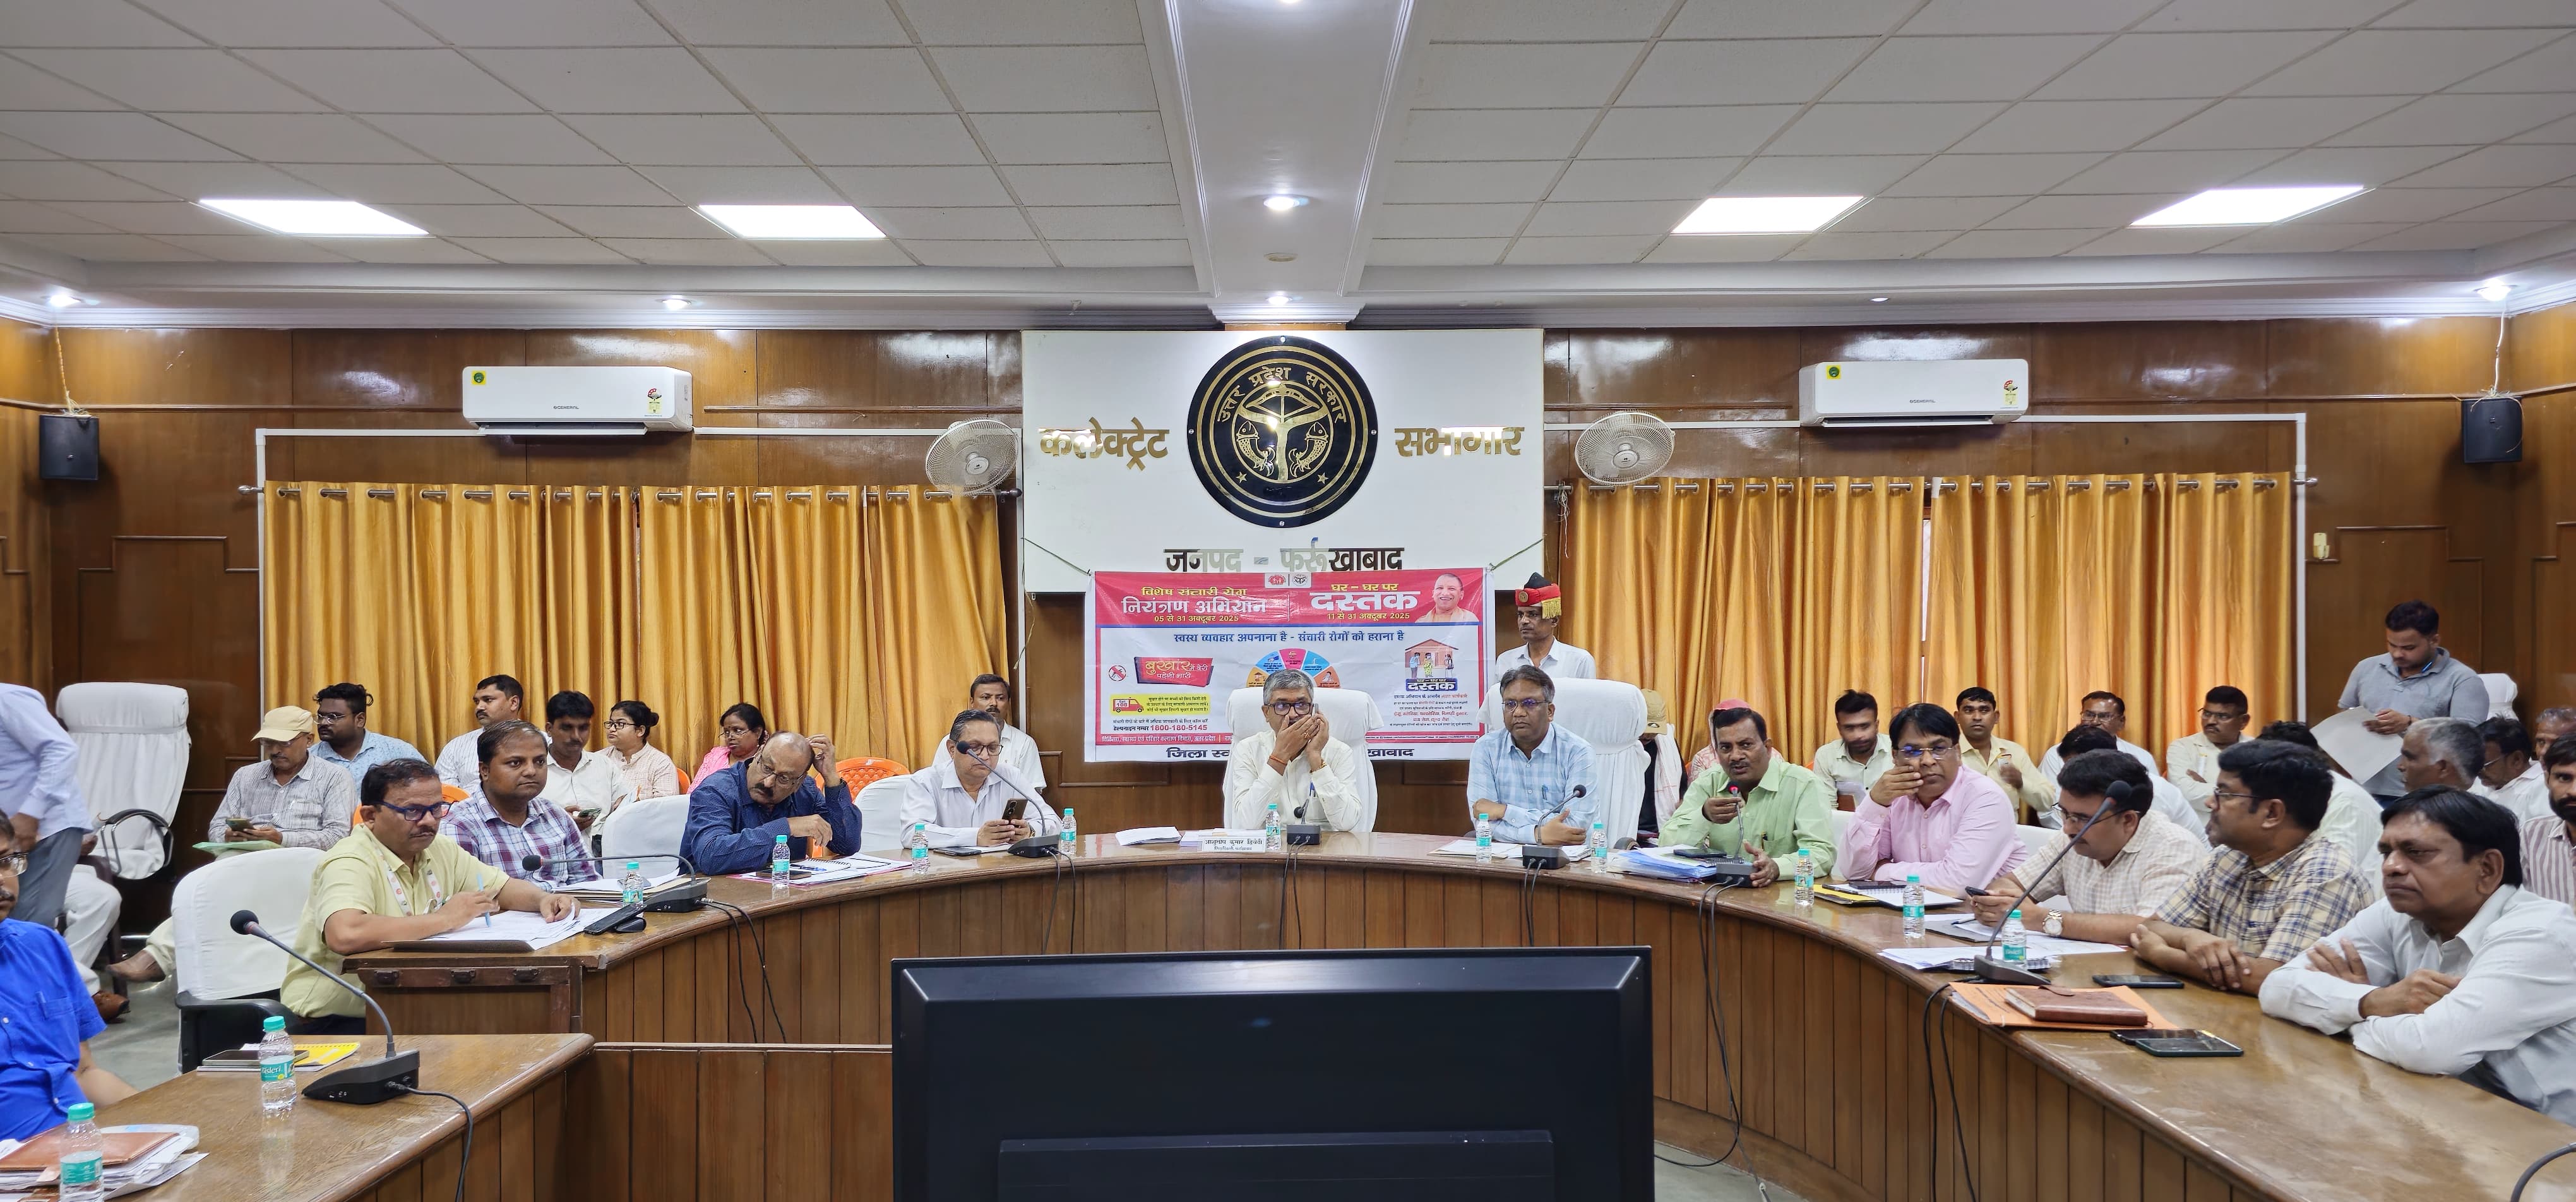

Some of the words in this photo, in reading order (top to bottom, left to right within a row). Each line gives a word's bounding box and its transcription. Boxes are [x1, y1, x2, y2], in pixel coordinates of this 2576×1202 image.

[1217, 385, 1245, 423] उत्तर
[1248, 366, 1291, 387] प्रदेश
[1306, 371, 1347, 423] सरकार
[1039, 417, 1169, 471] कलेक्ट्रेट
[1394, 426, 1525, 457] सभागार
[1164, 548, 1244, 572] जनपद
[1142, 587, 1173, 596] विशेष
[1178, 586, 1219, 596] संचारी
[1222, 587, 1248, 596] रोग
[1362, 583, 1380, 591] घर
[1121, 596, 1190, 614] नियंत्रण
[1195, 596, 1267, 613] अभियान
[1309, 591, 1421, 611] दस्तक
[1167, 614, 1174, 622] से
[1188, 615, 1216, 623] अक्टूबर
[1337, 611, 1345, 620] से
[1359, 613, 1387, 622] अक्टूबर
[1174, 634, 1198, 642] स्वस्थ
[1202, 634, 1232, 642] व्यवहार
[1237, 634, 1277, 642] अपनाना
[1280, 630, 1289, 642] है
[1298, 631, 1327, 642] संचारी
[1329, 631, 1350, 642] रोगों
[1352, 632, 1365, 642] को
[1368, 632, 1395, 641] हराना
[1398, 630, 1405, 641] है
[1145, 659, 1191, 675] बुखार
[1407, 682, 1456, 690] दस्तक
[1166, 747, 1208, 758] जिला
[1212, 749, 1230, 758] स्व
[1368, 748, 1414, 757] खाबाद
